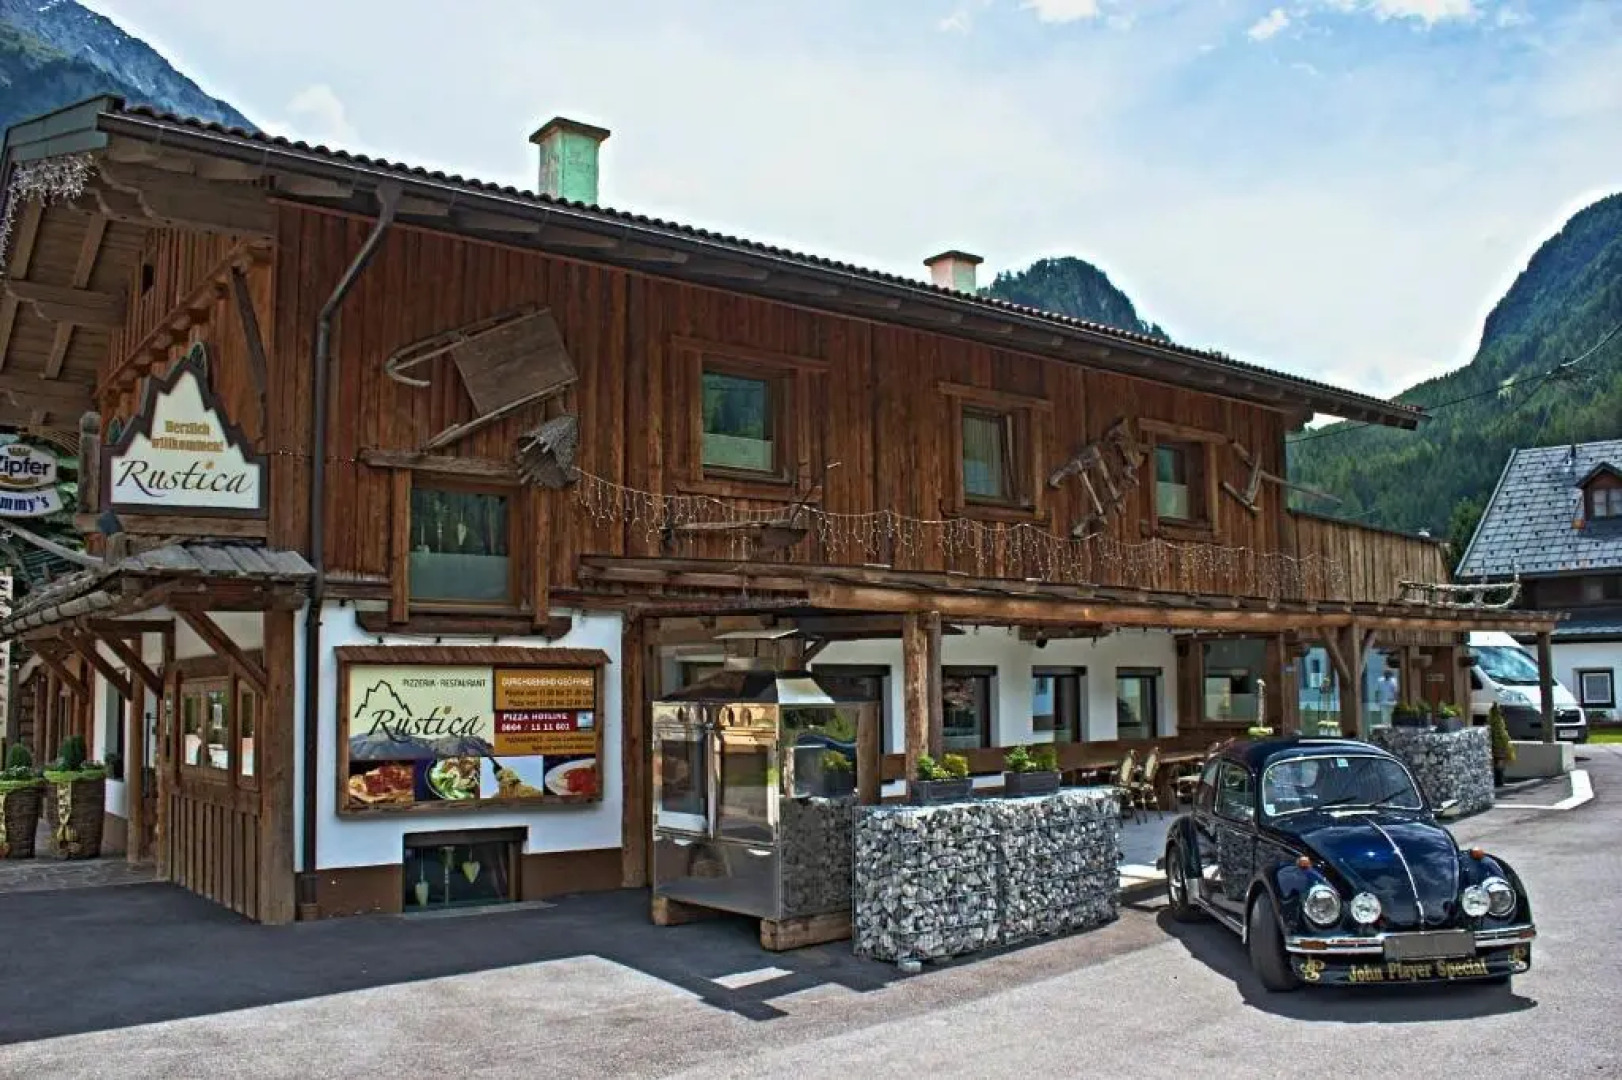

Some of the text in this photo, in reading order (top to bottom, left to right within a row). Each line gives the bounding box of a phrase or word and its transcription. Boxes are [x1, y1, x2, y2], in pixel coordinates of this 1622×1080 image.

[115, 460, 253, 498] Rustica
[403, 678, 436, 688] PIZZERIA
[441, 678, 486, 688] RESTAURANT
[368, 706, 486, 743] Rustica
[503, 712, 569, 721] PIZZA HOTLINE
[1349, 963, 1384, 982] John
[1388, 960, 1432, 981] Player
[1437, 957, 1489, 979] Special
